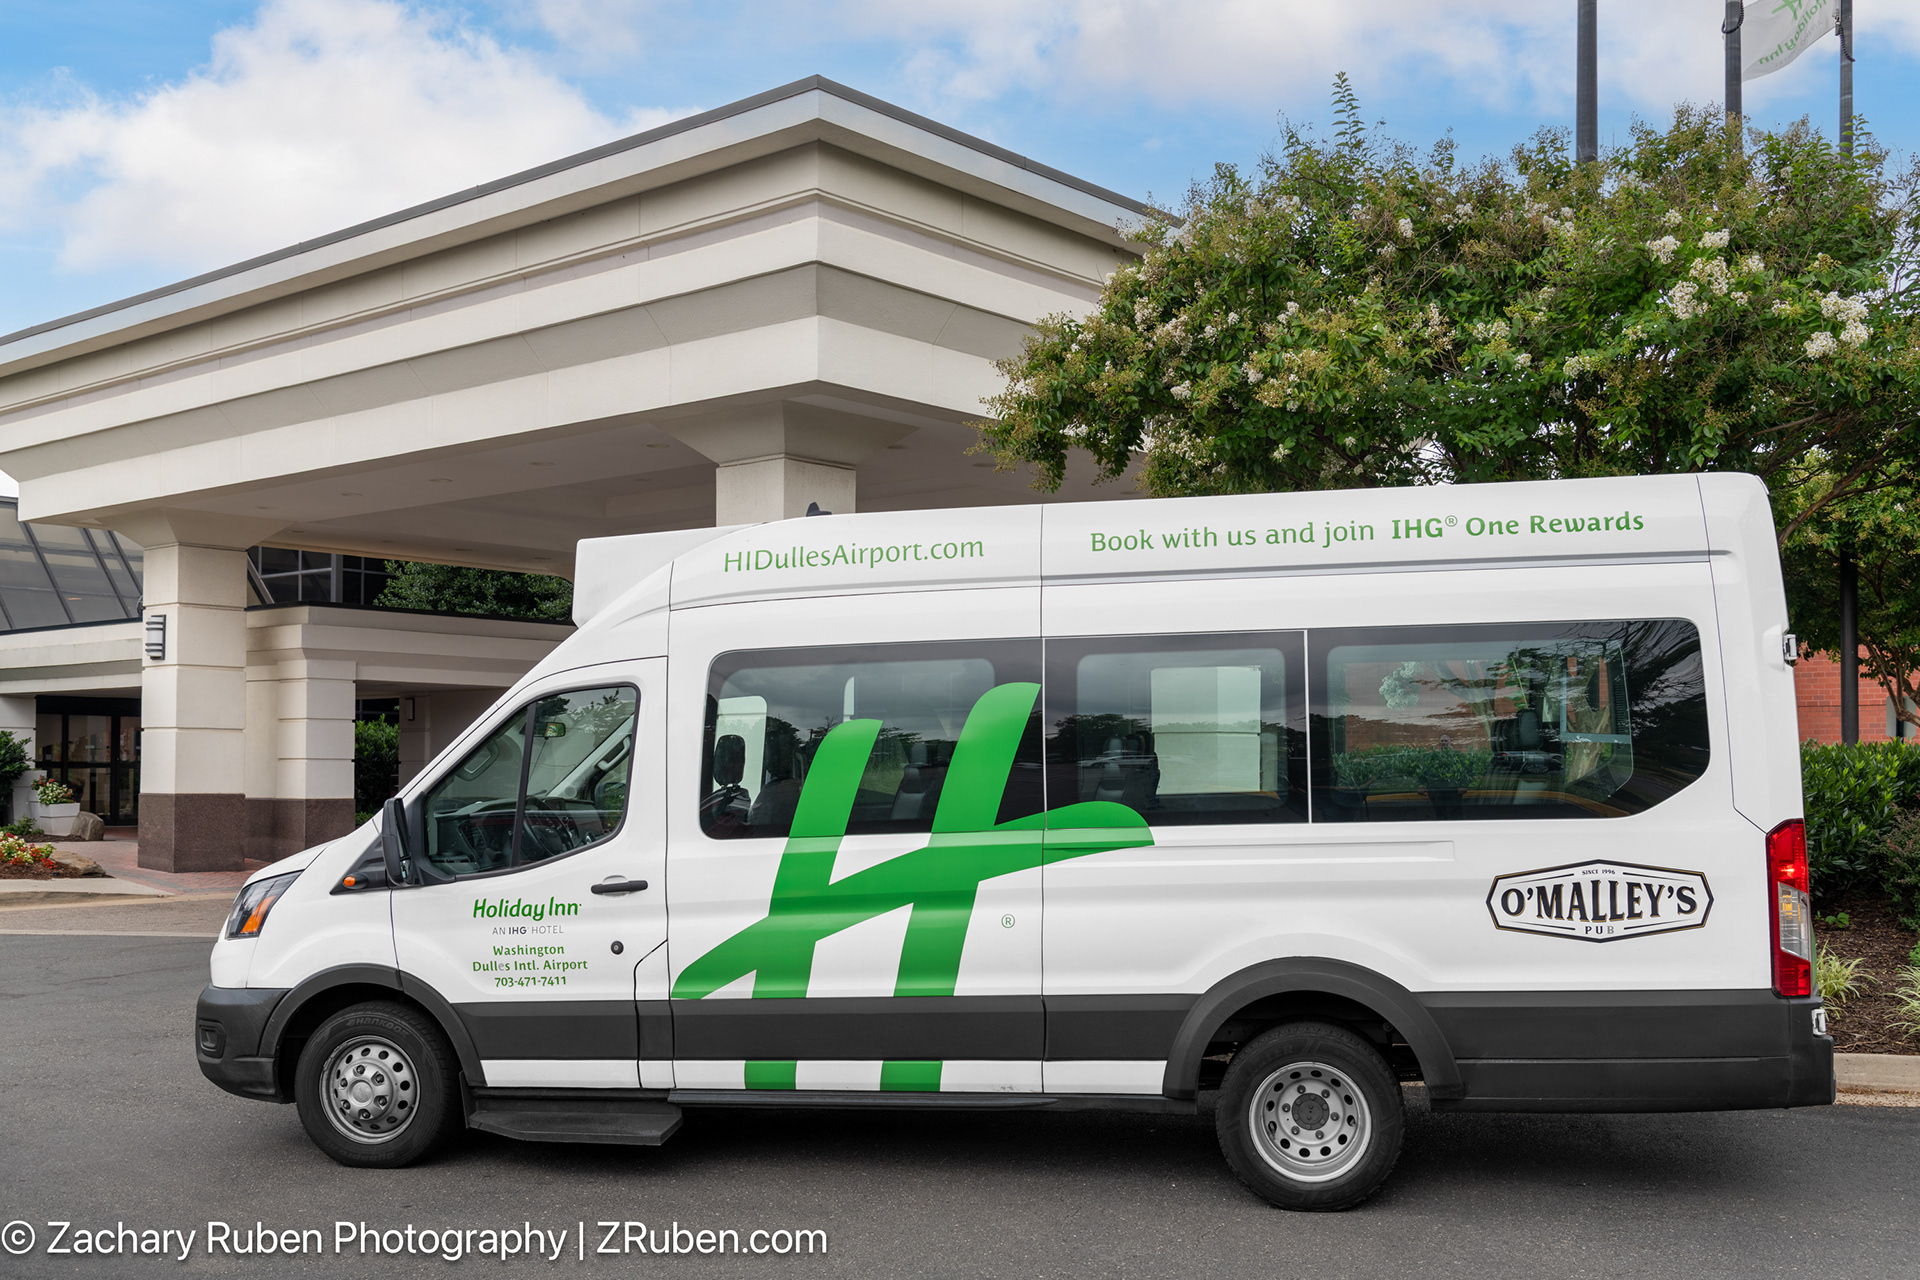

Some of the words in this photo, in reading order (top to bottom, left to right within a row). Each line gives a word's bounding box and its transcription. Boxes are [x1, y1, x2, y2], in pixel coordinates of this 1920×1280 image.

[1090, 529, 1155, 552] Book
[1161, 526, 1218, 549] with
[1227, 529, 1257, 547] us
[1265, 521, 1316, 545] and
[1322, 519, 1374, 549] join
[1465, 517, 1520, 537] One
[1529, 510, 1645, 534] Rewards
[724, 540, 985, 573] HIDullesAirport.com
[1581, 868, 1599, 876] SINCE
[1500, 879, 1698, 923] O’MALLEY’S
[472, 897, 546, 922] Holiday
[548, 896, 579, 917] Inn
[491, 926, 506, 936] AN
[508, 926, 528, 935] IHG
[531, 925, 564, 935] HOTEL
[1584, 925, 1615, 935] PUB
[492, 944, 565, 958] Washington
[472, 960, 511, 972] Dulles
[514, 960, 540, 971] Intl.
[543, 959, 588, 972] Airport
[494, 975, 567, 988] 703-471-7411
